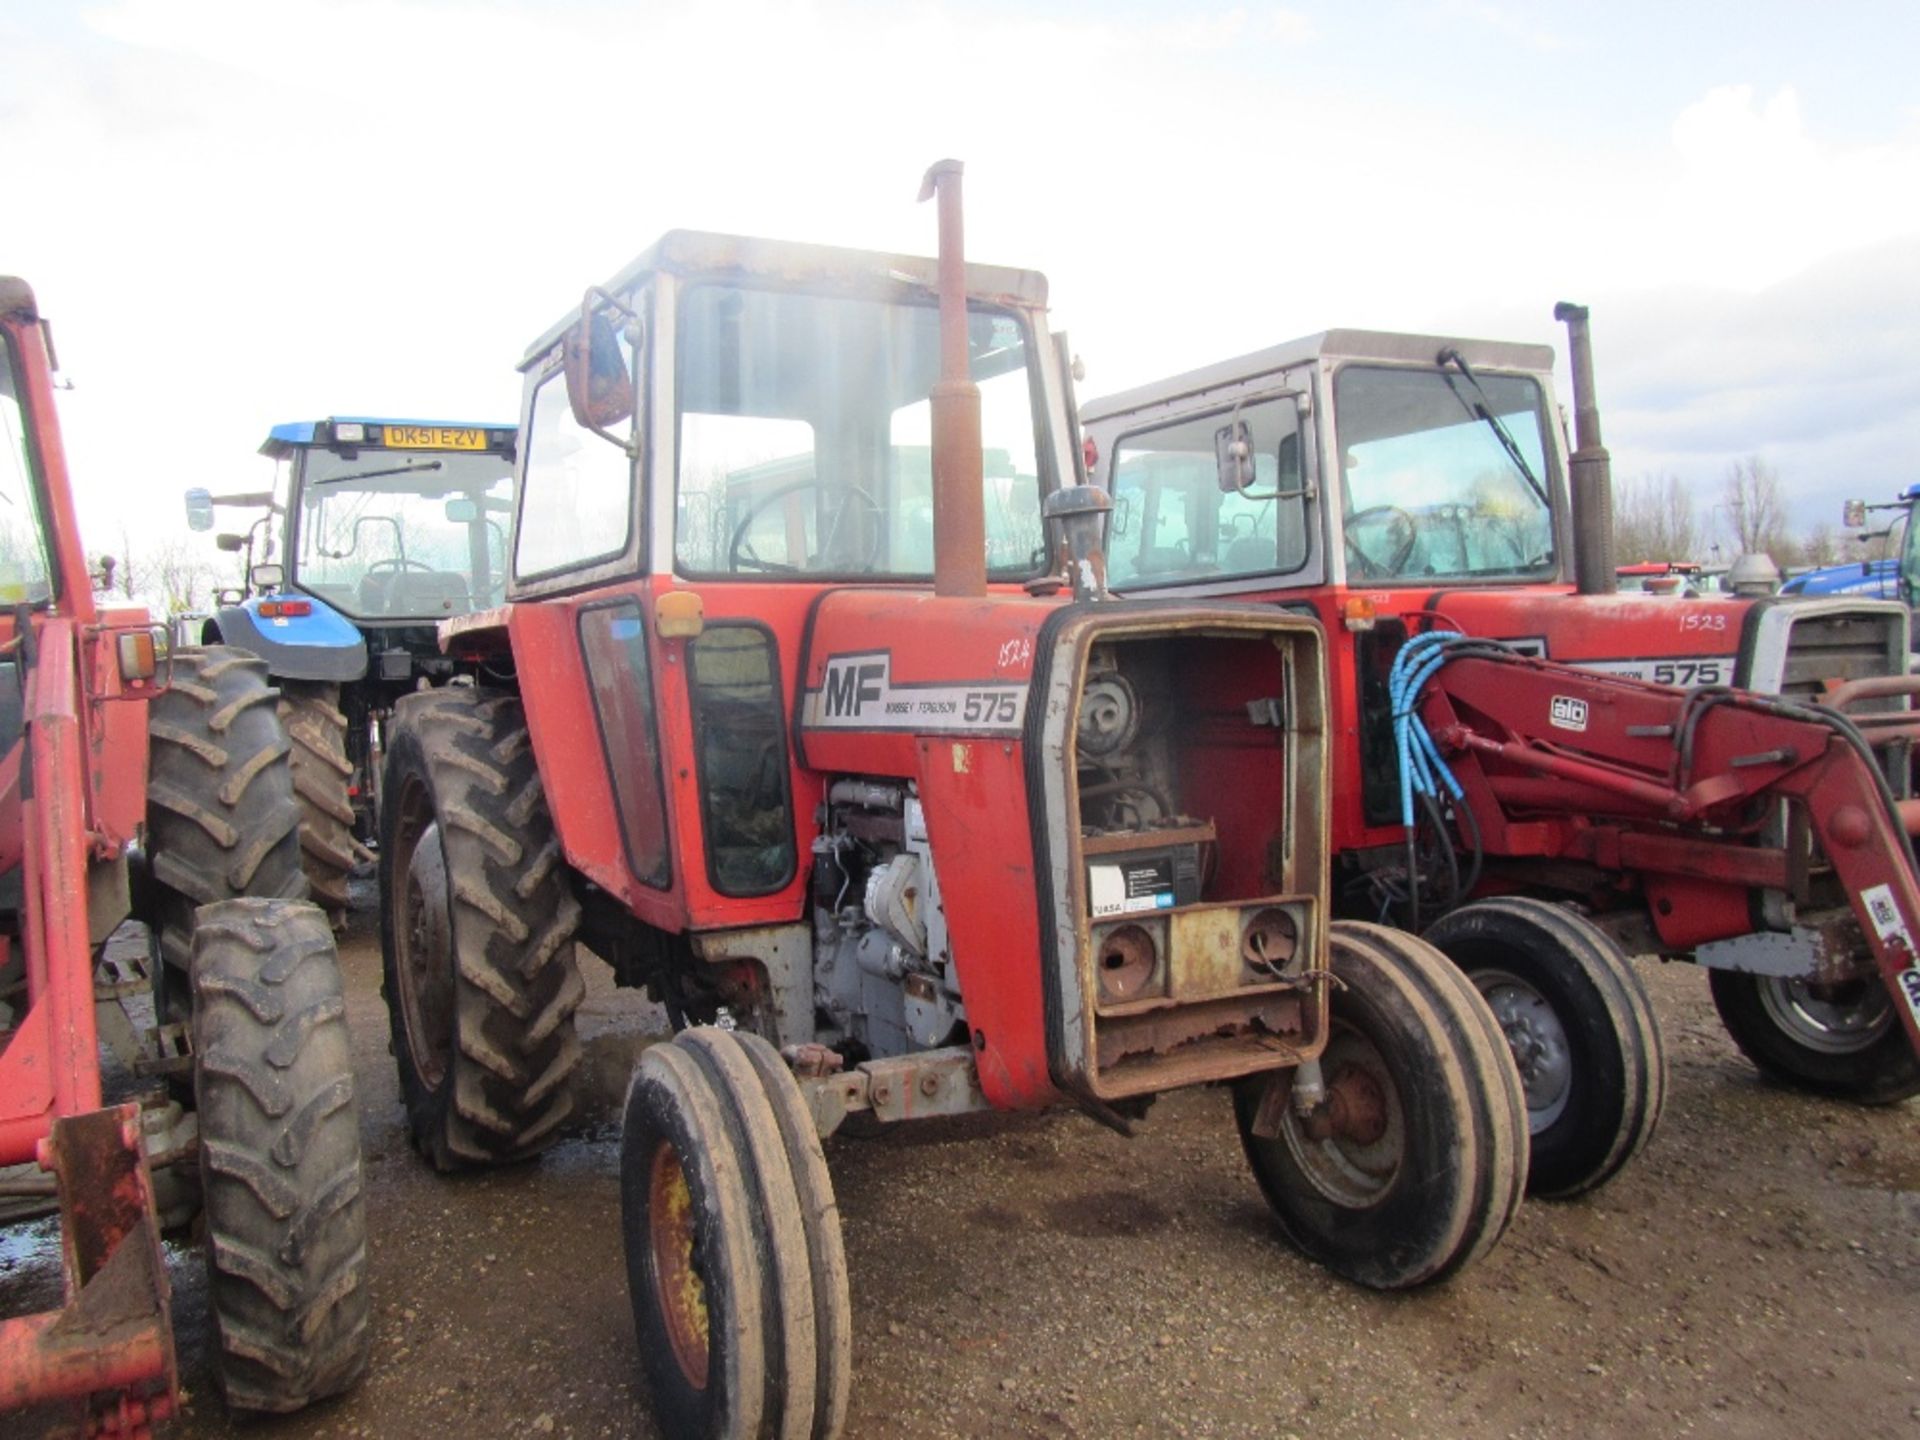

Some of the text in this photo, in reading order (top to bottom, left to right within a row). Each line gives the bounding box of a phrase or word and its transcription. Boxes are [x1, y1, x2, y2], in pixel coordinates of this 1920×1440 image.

[391, 426, 478, 447] DK51 EZV
[1679, 615, 1726, 632] 1523
[1654, 663, 1719, 685] 575
[825, 664, 885, 717] MF
[963, 692, 1018, 723] 575
